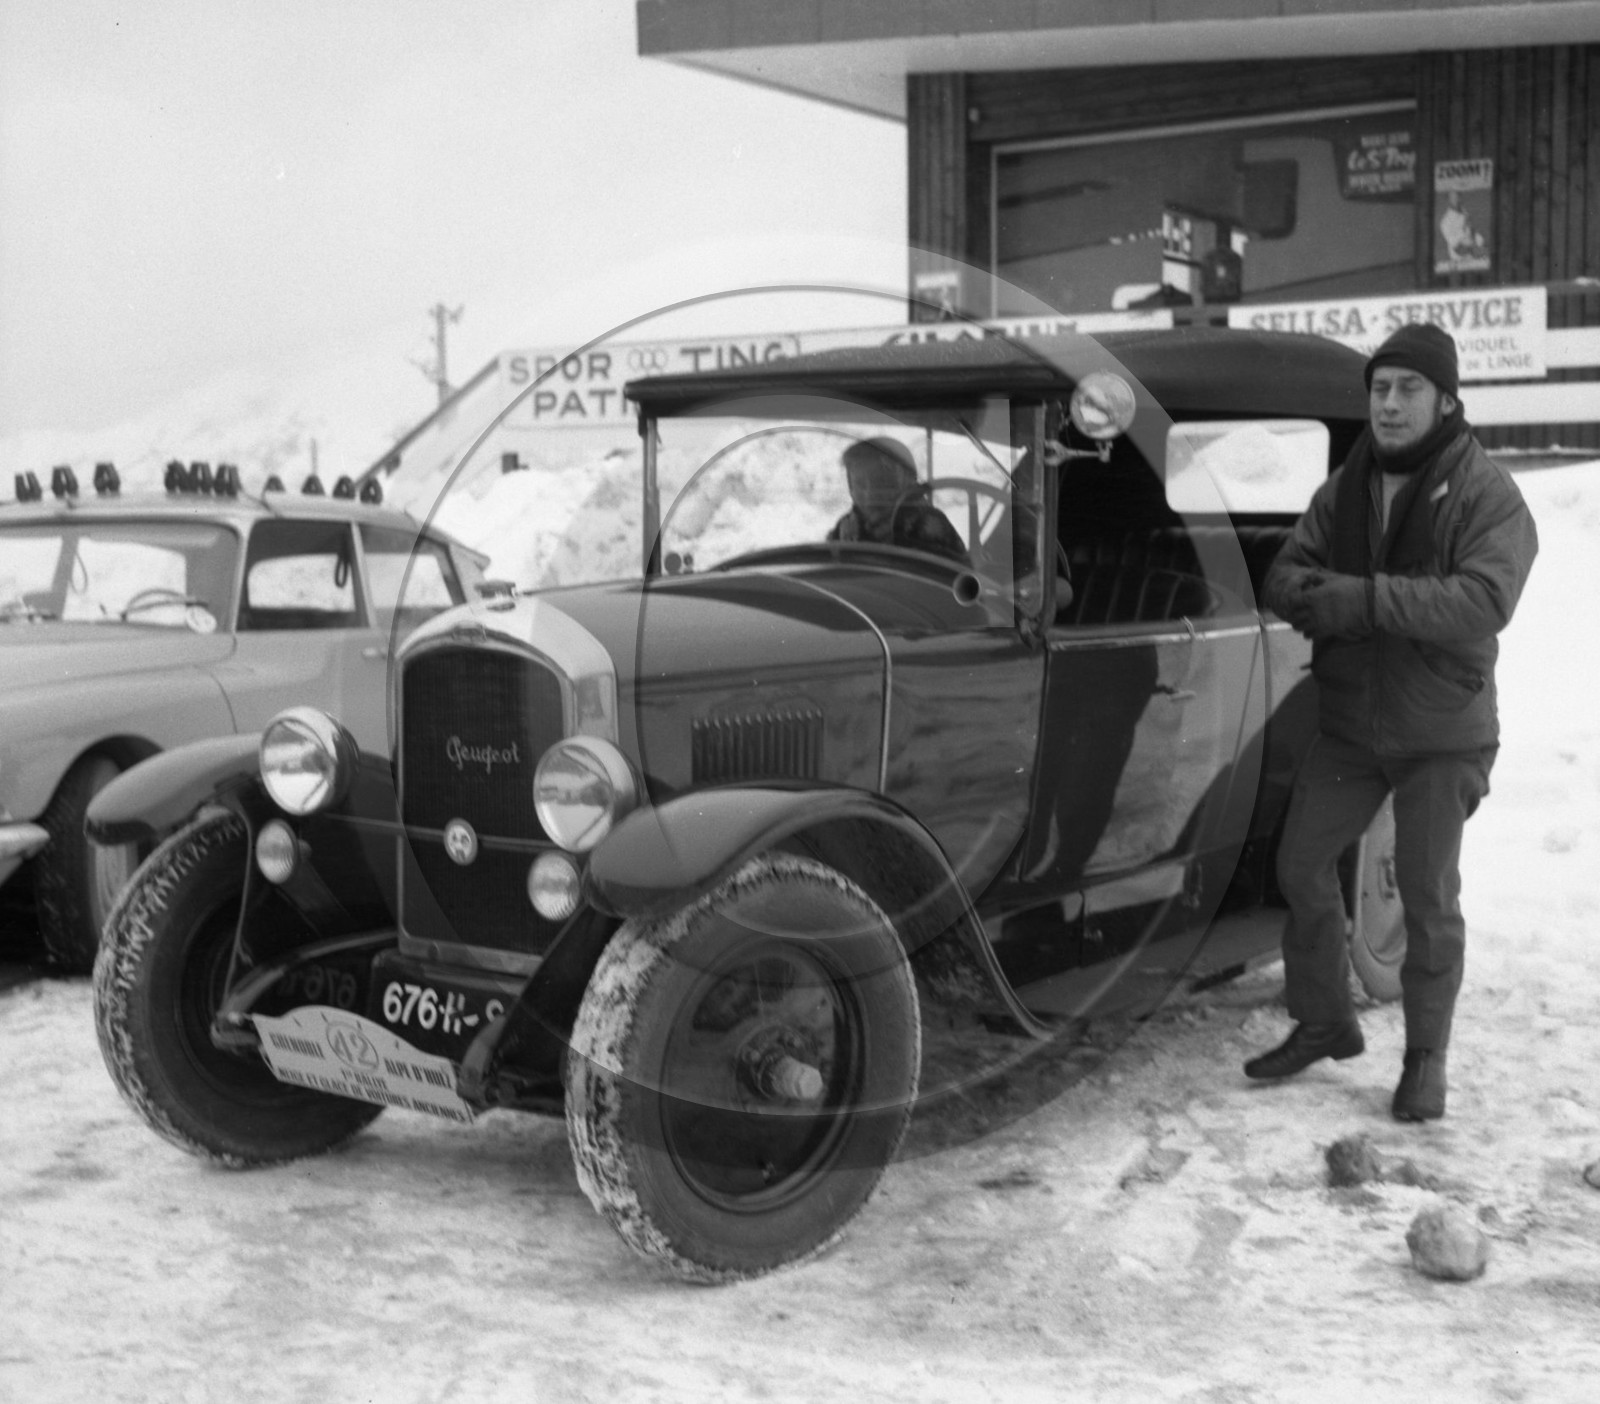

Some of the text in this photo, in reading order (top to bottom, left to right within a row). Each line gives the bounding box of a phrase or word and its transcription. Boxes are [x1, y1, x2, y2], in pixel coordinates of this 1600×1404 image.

[1384, 297, 1522, 333] SERVICE
[1458, 337, 1518, 352] VIDUEL
[509, 353, 612, 384] SPOR
[533, 387, 628, 417] PATI
[446, 735, 521, 775] Peugeot
[335, 1028, 377, 1068] 42
